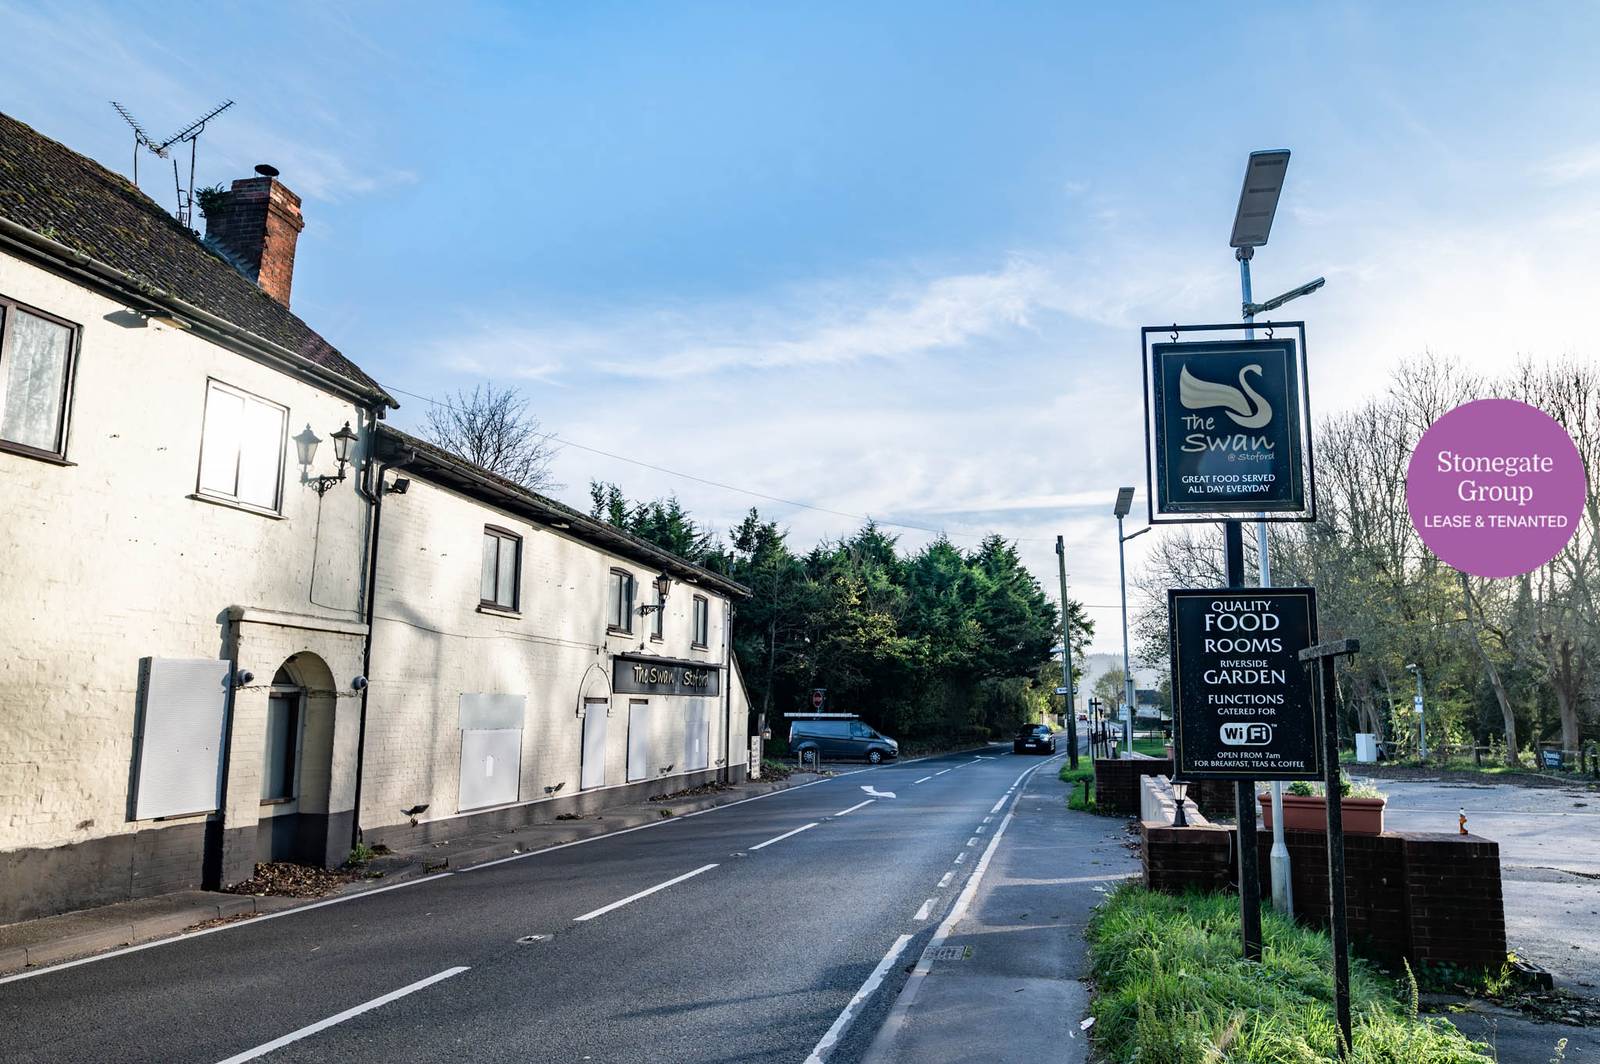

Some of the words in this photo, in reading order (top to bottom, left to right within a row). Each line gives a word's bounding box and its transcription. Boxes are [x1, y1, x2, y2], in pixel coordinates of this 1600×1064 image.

[1181, 414, 1215, 431] The
[1181, 433, 1275, 453] Swan
[1227, 453, 1236, 462] @
[1237, 452, 1275, 463] Stoford
[1181, 475, 1210, 484] GREAT
[1212, 474, 1240, 483] FOOD
[1242, 474, 1276, 482] SERVED
[1188, 485, 1204, 494] ALL
[1207, 484, 1225, 493] DAY
[1226, 484, 1270, 493] EVERYDAY
[1211, 600, 1272, 614] QUALITY
[1204, 613, 1280, 632] FOOD
[1204, 638, 1283, 653] ROOMS
[1220, 659, 1269, 668] RIVERSIDE
[633, 664, 649, 684] The
[1203, 669, 1286, 685] GARDEN
[1208, 694, 1284, 705] FUNCTIONS
[1217, 707, 1256, 715] CATERED
[1217, 751, 1239, 759] OPEN
[1240, 751, 1263, 759] FROM
[1194, 760, 1209, 768] FOR
[1210, 760, 1250, 768] BREAKFAST,
[1278, 760, 1304, 768] COFFEE
